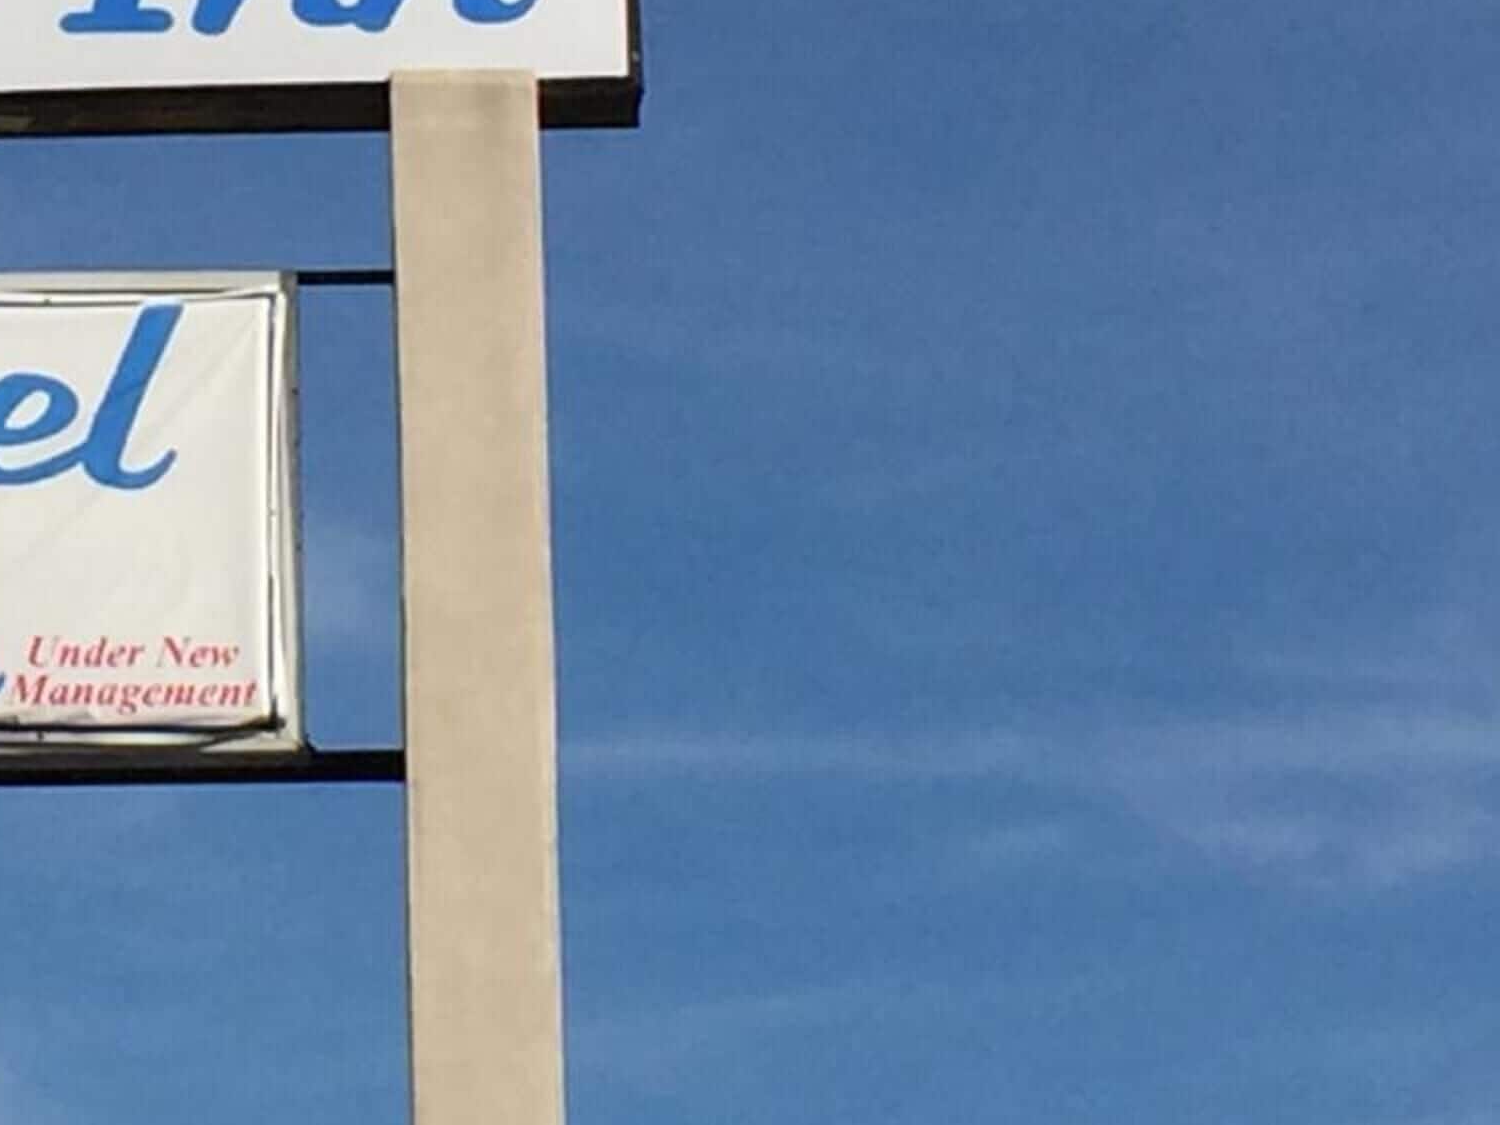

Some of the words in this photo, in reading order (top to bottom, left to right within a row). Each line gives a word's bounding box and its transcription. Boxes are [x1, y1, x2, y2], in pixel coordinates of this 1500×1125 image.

[26, 635, 146, 668] Under
[156, 635, 241, 668] New
[11, 674, 258, 715] Management
